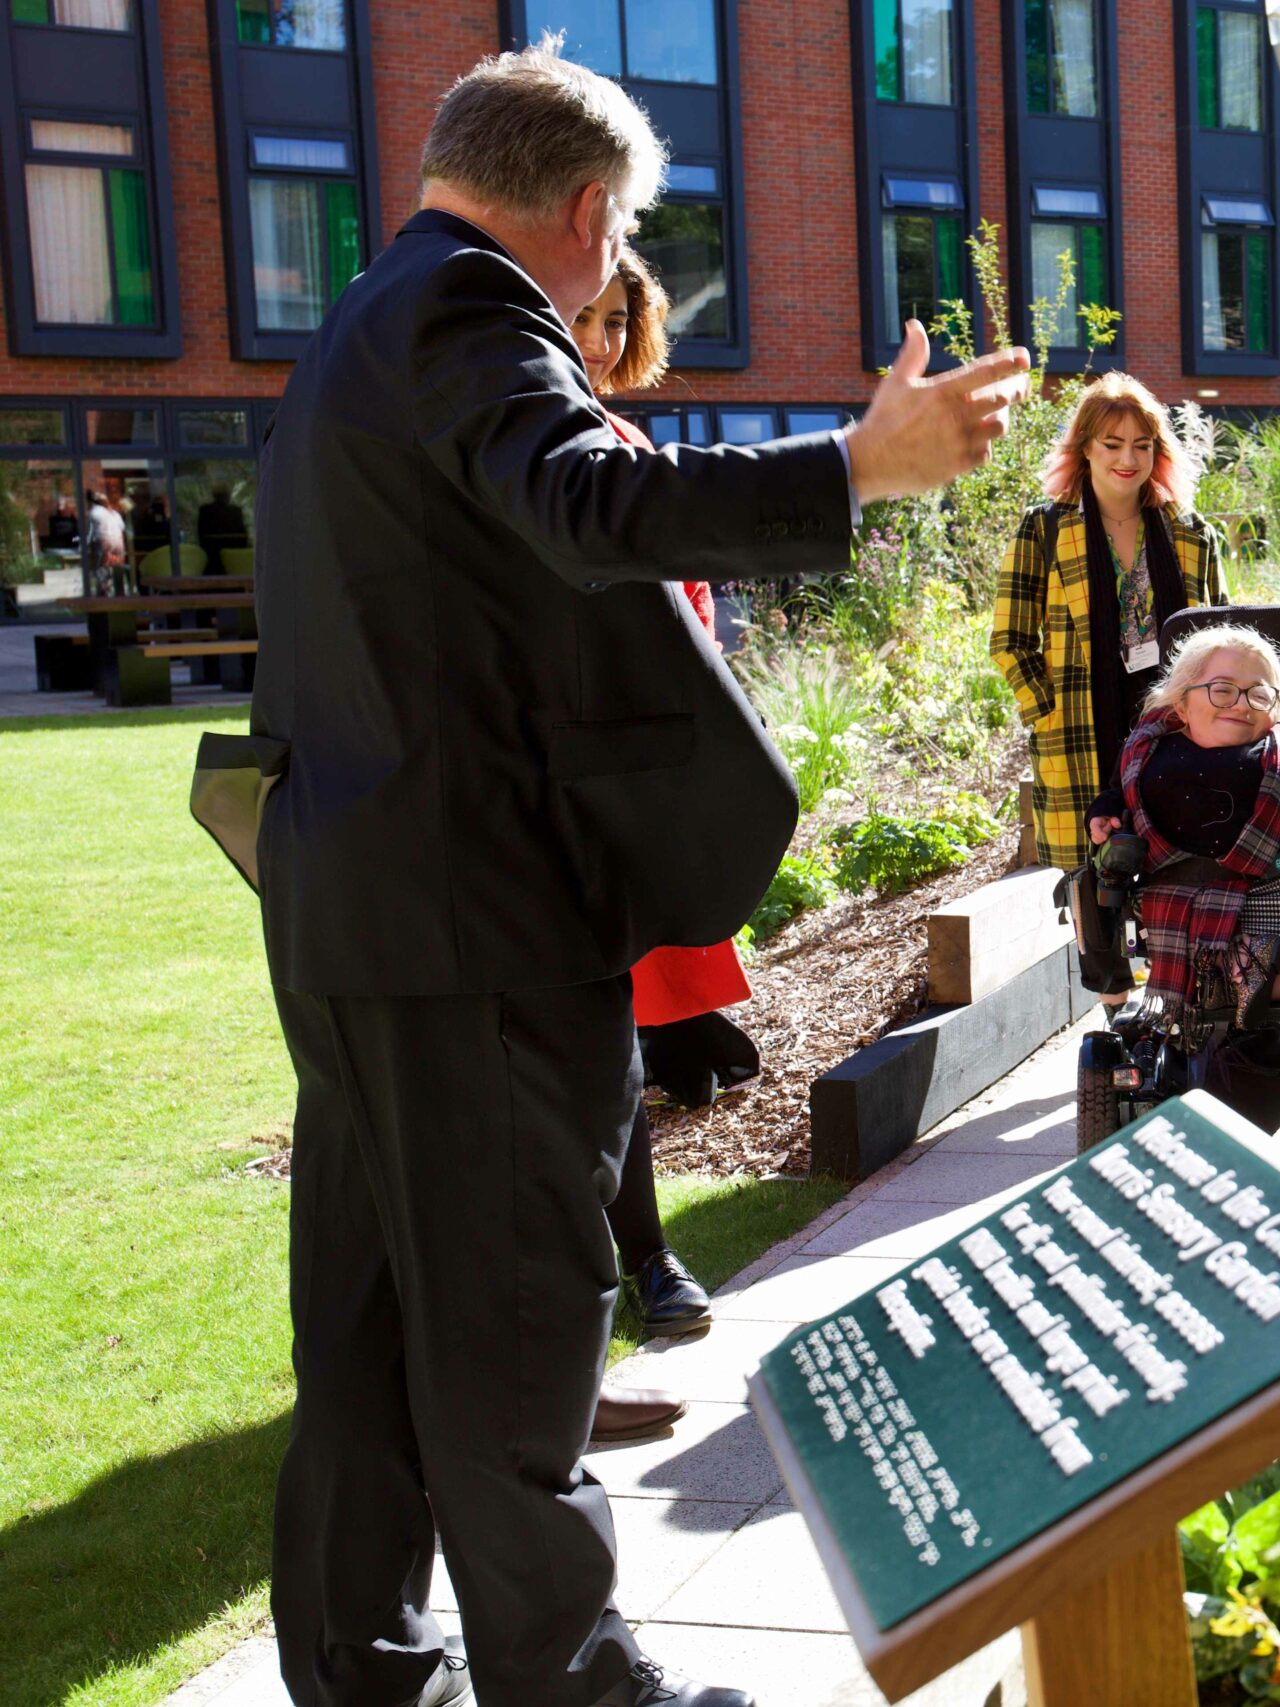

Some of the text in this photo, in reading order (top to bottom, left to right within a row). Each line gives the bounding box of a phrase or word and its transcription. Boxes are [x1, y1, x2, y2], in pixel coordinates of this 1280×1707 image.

[1088, 1142, 1155, 1199] Morris
[1136, 1182, 1223, 1261] Sensory
[1132, 1115, 1219, 1187] Welcome
[1200, 1169, 1239, 1203] to
[1220, 1185, 1271, 1228] the
[1000, 1201, 1033, 1231] for
[1154, 1290, 1225, 1353] access
